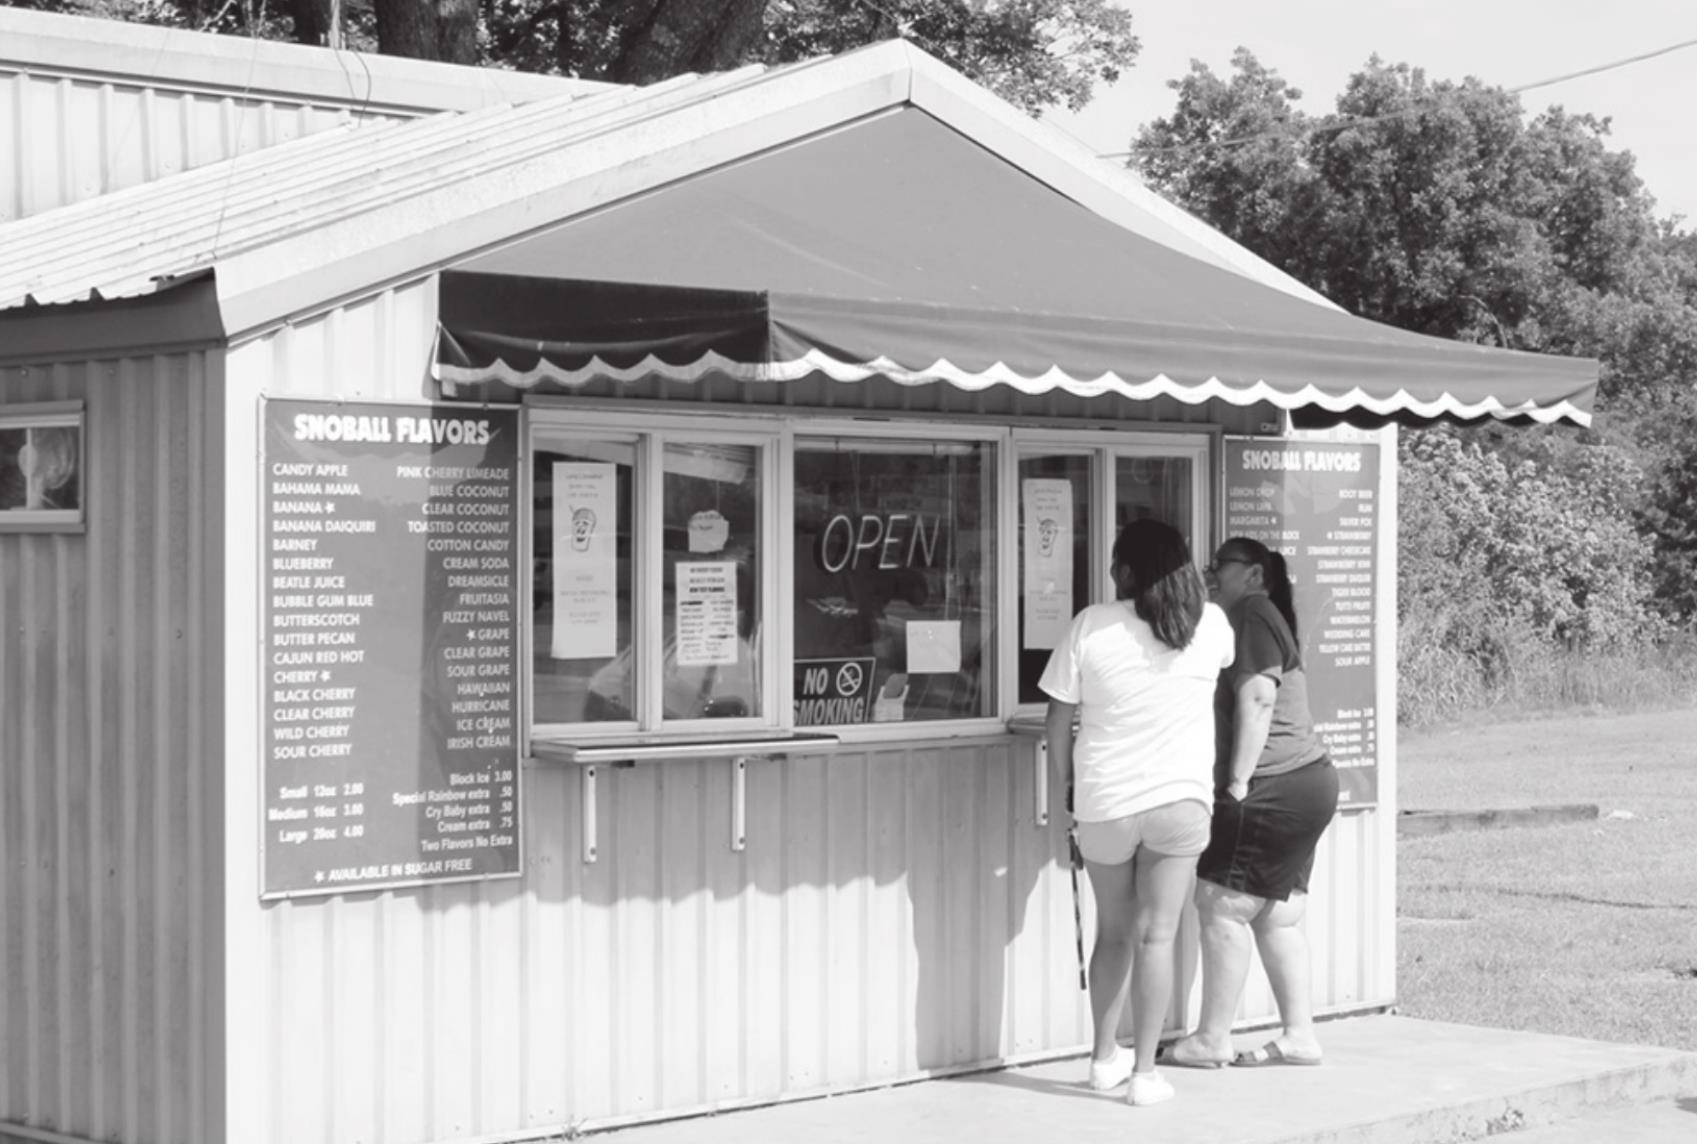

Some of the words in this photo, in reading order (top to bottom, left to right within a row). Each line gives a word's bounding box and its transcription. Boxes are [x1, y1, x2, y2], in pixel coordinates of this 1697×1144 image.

[294, 414, 391, 442] SNOBALL
[396, 417, 490, 445] FLAVORS
[1242, 450, 1301, 470] SNOBALL
[1304, 452, 1361, 471] FLAVORS
[273, 464, 313, 477] CANDY
[316, 464, 348, 477] APPLE
[397, 466, 422, 478] PINK
[424, 467, 464, 479] CHERRY
[466, 467, 509, 480] LIMEADE
[273, 483, 322, 495] BAHAMA
[325, 483, 360, 496] MAMA
[430, 485, 454, 496] BLUE
[456, 485, 509, 498] COCONUT
[273, 501, 322, 513] BANANA
[422, 504, 454, 515] CLEAR
[456, 504, 509, 515] COCONUT
[273, 521, 322, 532] BANANA
[325, 521, 376, 533] DAIQUIRI
[407, 521, 454, 533] TOASTED
[456, 522, 509, 533] COCONUT
[273, 539, 317, 551] BARNEY
[427, 539, 471, 551] COTTON
[474, 539, 509, 552] CANDY
[821, 514, 940, 573] OPEN
[273, 558, 333, 569] BLUEBERRY
[443, 558, 478, 569] CREAM
[481, 558, 509, 569] SODA
[273, 577, 310, 588] BEATLE
[313, 576, 345, 588] JUICE
[448, 576, 509, 587] DREAMSICLE
[273, 595, 314, 607] BUBBLE
[316, 595, 345, 607] GUM
[347, 594, 373, 606] BLUE
[459, 594, 509, 605] FRUITASIA
[274, 614, 360, 626] BUTTERSCOTCH
[443, 612, 475, 623] FUZZY
[478, 611, 509, 623] NAVEL
[274, 633, 315, 646] BUTTER
[317, 632, 355, 645] PECAN
[478, 629, 509, 640] GRAPE
[274, 652, 313, 665] CAJUN
[316, 651, 338, 663] RED
[340, 650, 364, 663] HOT
[444, 648, 476, 660] CLEAR
[478, 646, 509, 658] GRAPE
[274, 671, 317, 683] CHERRY
[447, 665, 475, 677] SOUR
[478, 664, 509, 676] GRAPE
[803, 668, 829, 695] NO
[274, 690, 310, 703] BLACK
[312, 688, 355, 701] CHERRY
[458, 683, 510, 695] HAWAIIAN
[452, 701, 510, 713] HURRICANE
[793, 697, 865, 725] SMOKING
[274, 708, 309, 721] CLEAR
[312, 707, 355, 719] CHERRY
[457, 720, 474, 730] ICE
[476, 718, 510, 730] CREAM
[274, 727, 304, 740] WILD
[306, 726, 350, 738] CHERRY
[447, 738, 474, 749] IRISH
[478, 736, 510, 748] CREAM
[274, 746, 307, 759] SOUR
[309, 744, 352, 757] CHERRY
[450, 773, 476, 785] Block
[477, 773, 490, 783] Ice
[280, 786, 307, 799] Small
[393, 791, 426, 806] Special
[428, 791, 466, 802] Rainbow
[468, 789, 490, 799] extra
[269, 808, 308, 820] Medium
[425, 807, 442, 820] Cry
[443, 806, 466, 818] Baby
[468, 805, 490, 815] extra
[438, 822, 466, 833] Cream
[468, 820, 490, 830] extra
[279, 830, 308, 844] Large
[421, 840, 440, 851] Two
[442, 838, 474, 850] Flavors
[476, 838, 488, 847] No
[490, 835, 512, 847] Extra
[328, 866, 389, 881] AVAILABLE
[391, 865, 403, 876] IN
[405, 861, 443, 875] SUGAR
[445, 859, 472, 871] FREE
